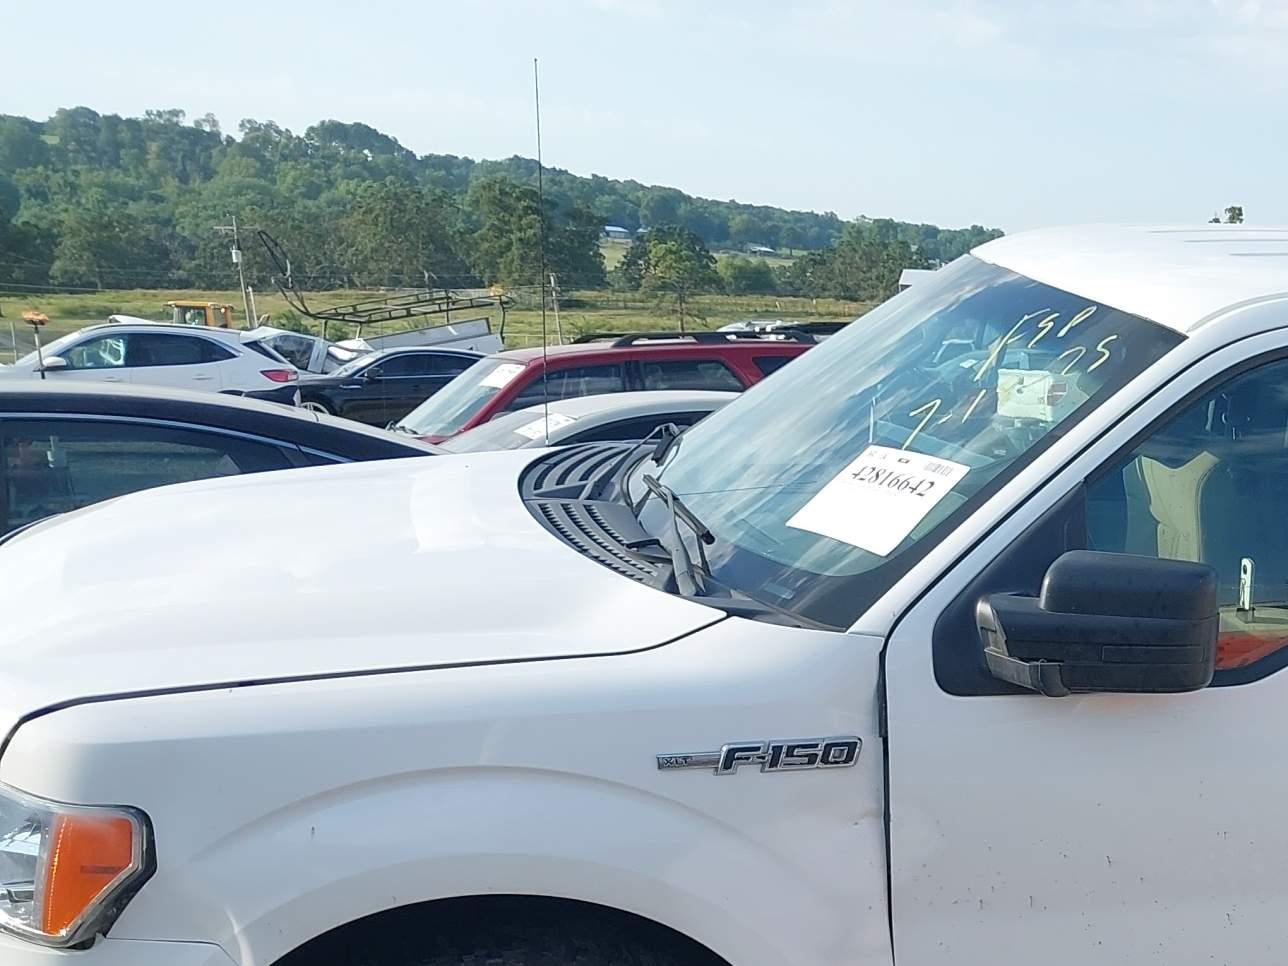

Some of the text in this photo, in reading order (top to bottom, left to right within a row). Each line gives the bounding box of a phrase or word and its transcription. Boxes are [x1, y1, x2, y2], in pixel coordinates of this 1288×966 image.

[851, 465, 936, 497] 42816642
[662, 736, 863, 776] XLT F-150
